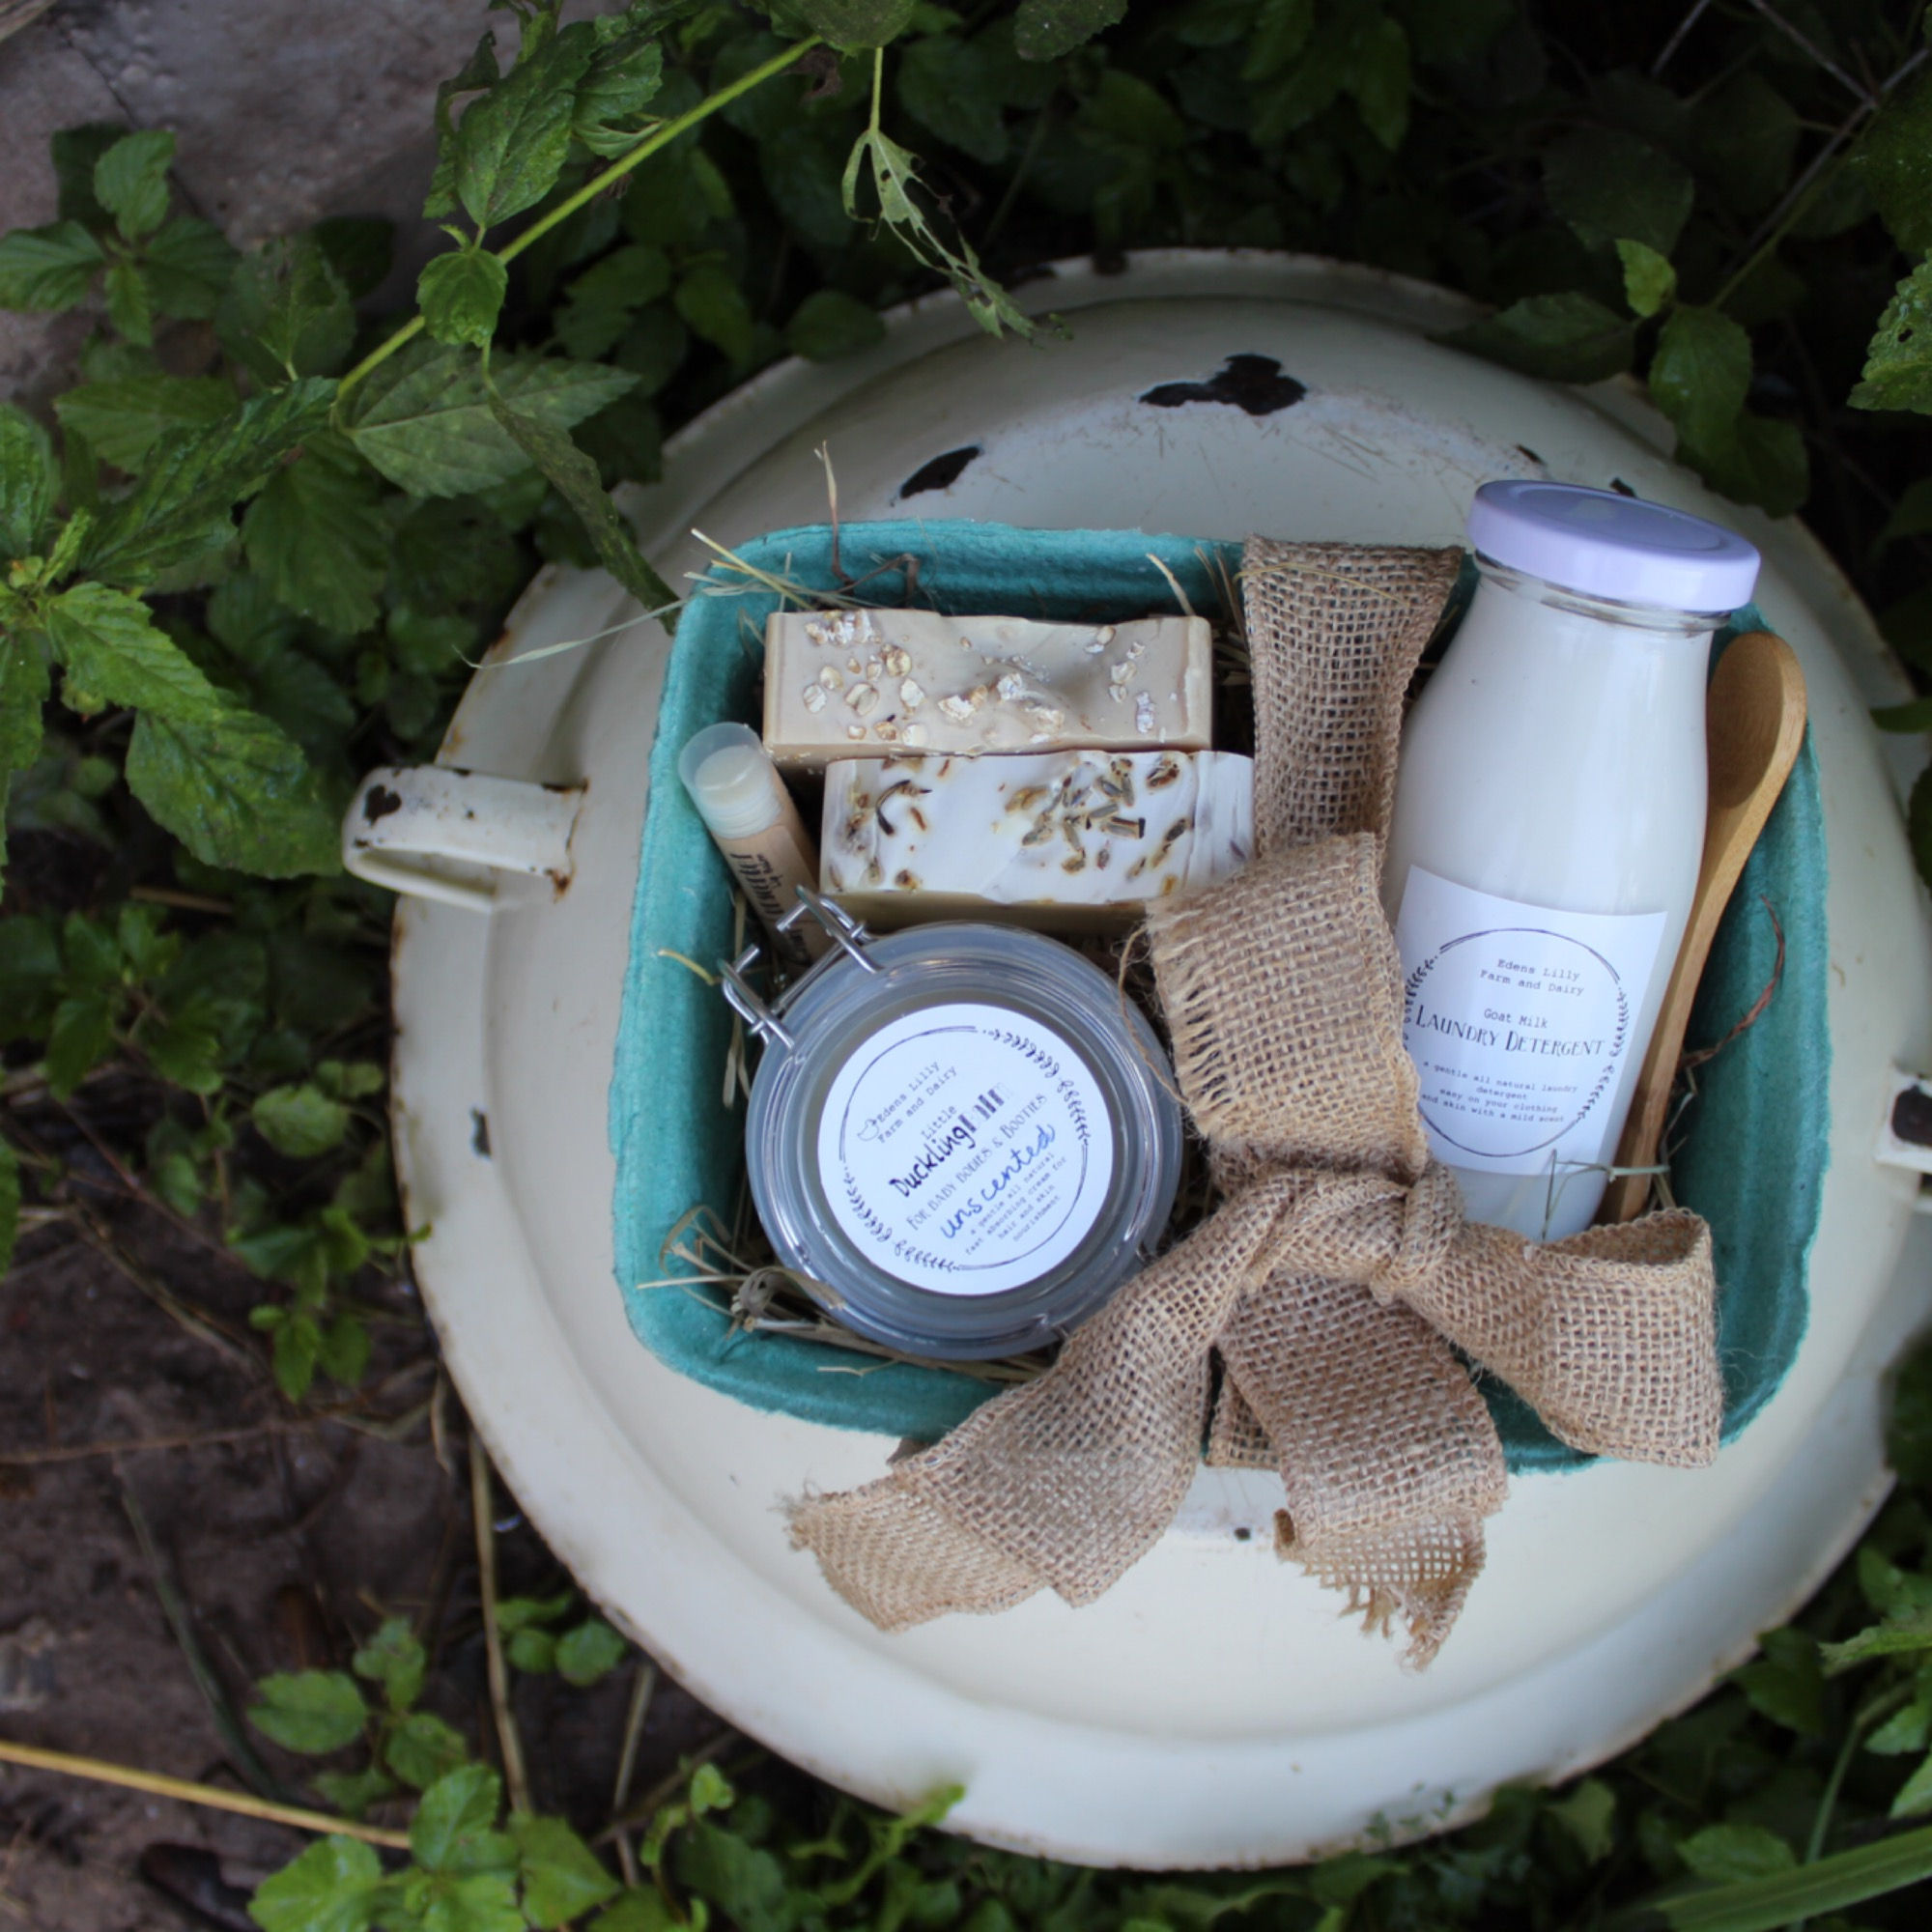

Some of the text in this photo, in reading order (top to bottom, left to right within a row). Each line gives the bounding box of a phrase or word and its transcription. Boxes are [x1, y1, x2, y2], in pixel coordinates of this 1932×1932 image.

[1497, 959, 1580, 982] Edens Lilly
[1480, 969, 1584, 996] Farm and Dairy
[1484, 1009, 1548, 1029] Goat Milk
[1434, 1065, 1467, 1078] gentle
[1473, 1075, 1490, 1084] all
[1496, 1080, 1535, 1091] natural
[1542, 1085, 1578, 1094] laundry
[876, 1062, 940, 1122] Edens Lilly
[1476, 1086, 1527, 1100] detergent
[875, 1066, 956, 1143] Farm and Dairy
[1471, 1106, 1494, 1117] with
[1485, 1099, 1509, 1108] your
[1514, 1102, 1558, 1114] clothing
[921, 1106, 957, 1140] Little
[992, 1137, 1004, 1149] &
[889, 1126, 976, 1197] Duckling
[1052, 1156, 1066, 1171] for
[1008, 1184, 1021, 1199] all
[1023, 1152, 1055, 1183] natural
[1019, 1204, 1034, 1219] and
